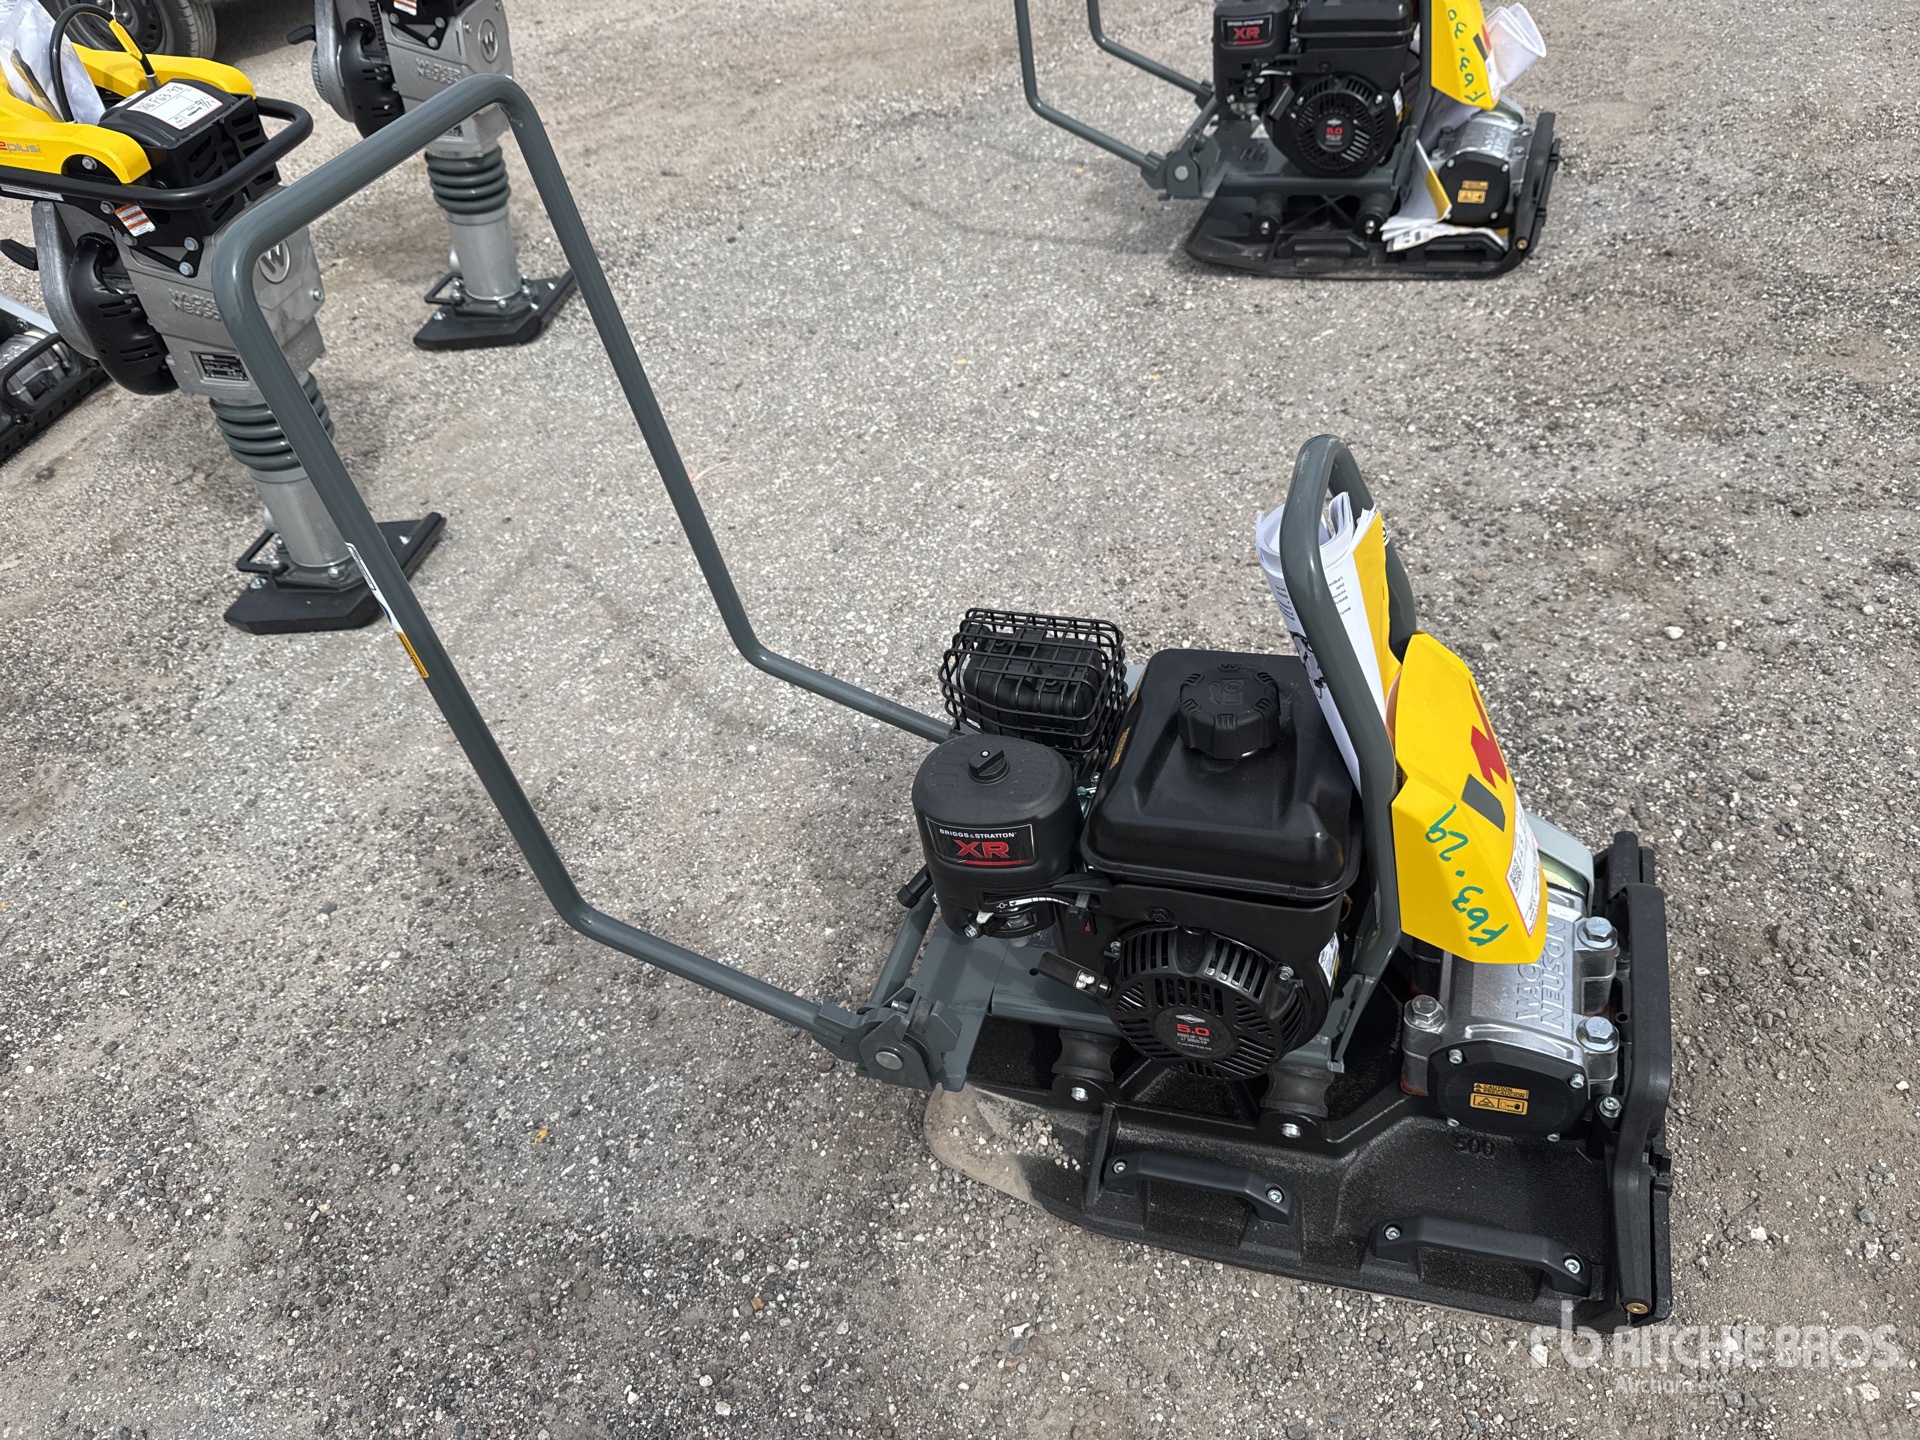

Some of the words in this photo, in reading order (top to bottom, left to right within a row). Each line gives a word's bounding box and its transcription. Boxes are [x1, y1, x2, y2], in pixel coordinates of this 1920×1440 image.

[1233, 26, 1260, 40] XR
[953, 839, 1010, 859] XR
[1176, 1023, 1210, 1036] 5.0
[1484, 1084, 1513, 1092] CAUTION
